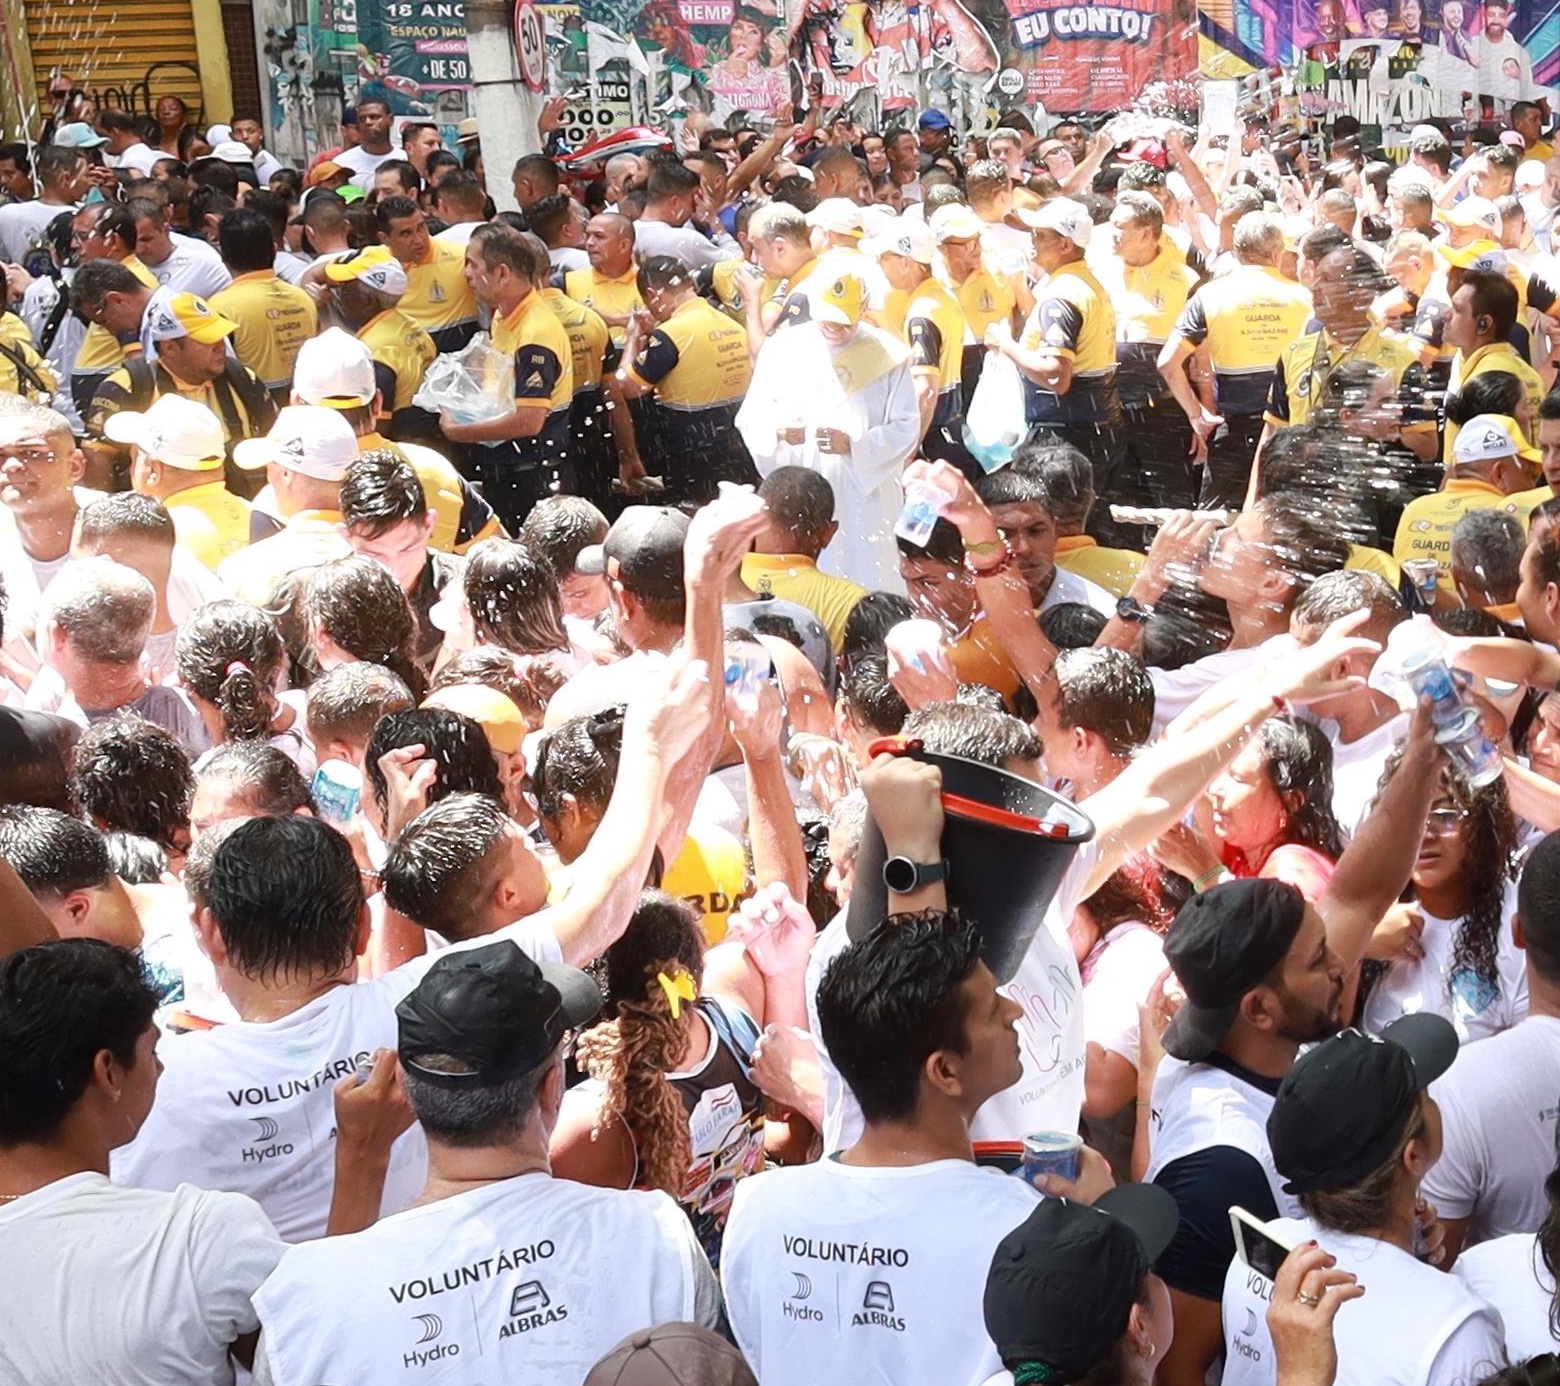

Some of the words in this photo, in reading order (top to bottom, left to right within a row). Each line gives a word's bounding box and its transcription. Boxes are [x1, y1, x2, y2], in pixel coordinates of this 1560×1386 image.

[386, 4, 413, 18] 18
[679, 4, 732, 21] HEMP
[391, 25, 437, 39] ESPAÇO
[520, 15, 539, 56] 50
[1014, 9, 1049, 44] EU
[1053, 7, 1152, 40] CONTO!
[450, 59, 467, 79] 50
[1245, 313, 1282, 324] GUARDA
[530, 354, 546, 365] RB
[1411, 539, 1450, 552] GUARD
[242, 1139, 295, 1162] Hydro
[783, 1234, 910, 1269] VOLUNTÁRIO
[389, 1238, 557, 1305] VOLUNTÁRIO
[782, 1301, 824, 1323] Hydro
[850, 1310, 906, 1332] ALBRAS
[403, 1341, 461, 1370] Hydro
[498, 1305, 569, 1341] ALBRAS
